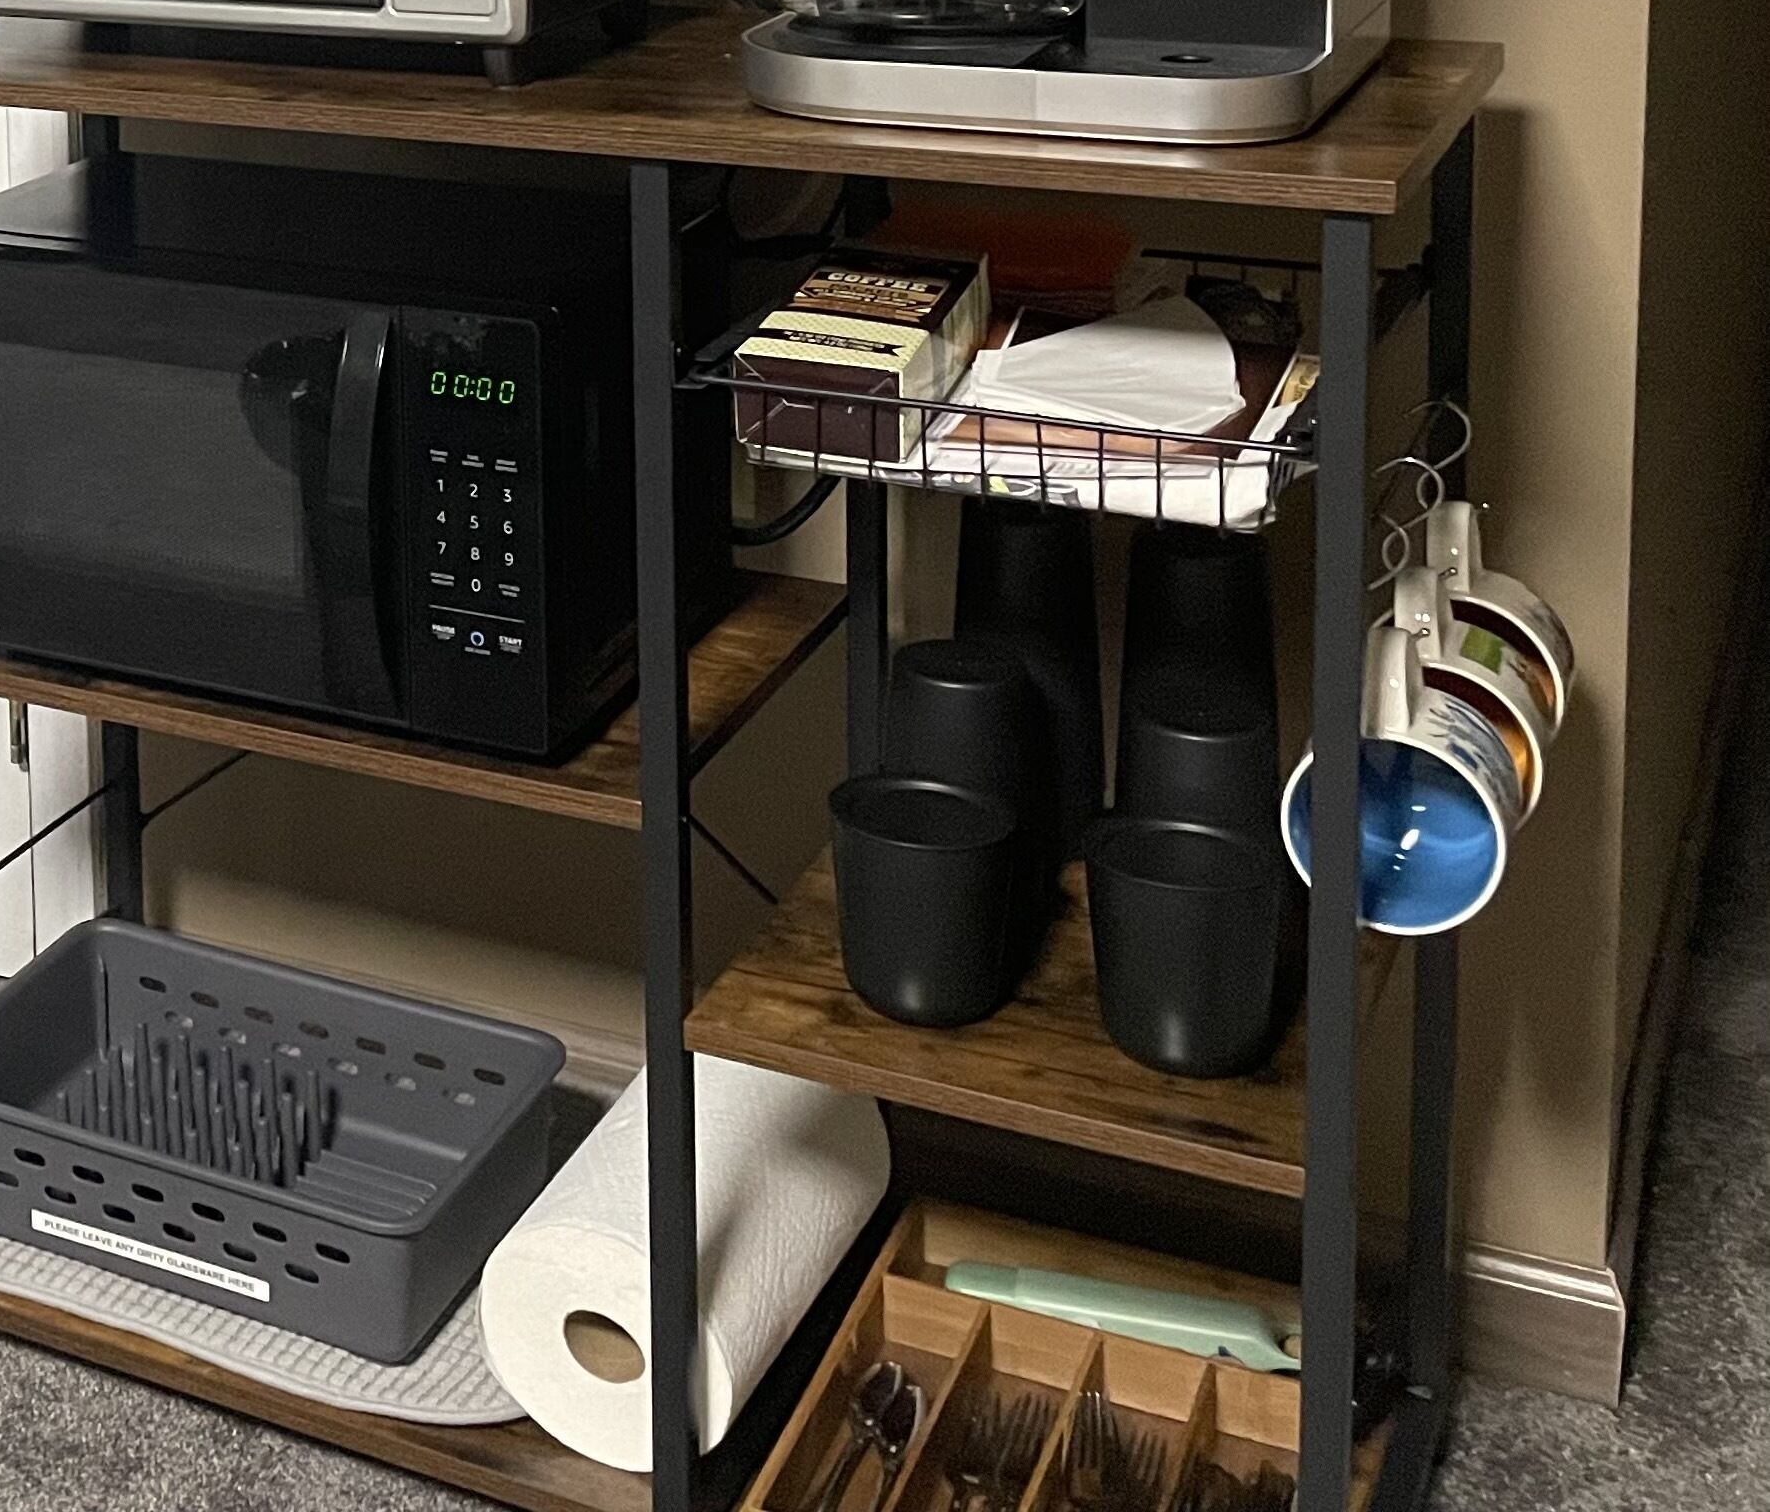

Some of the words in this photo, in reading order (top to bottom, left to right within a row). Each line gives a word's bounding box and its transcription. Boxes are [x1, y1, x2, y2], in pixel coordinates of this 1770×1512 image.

[827, 272, 929, 293] COFFEE
[430, 371, 516, 404] 00:00
[436, 478, 445, 493] 1
[468, 483, 479, 498] 2
[503, 488, 513, 503] 3
[436, 510, 447, 524] 4
[469, 515, 480, 530] 5
[503, 520, 514, 535] 6
[437, 541, 448, 555] 7
[470, 546, 481, 561] 8
[504, 552, 515, 567] 9
[470, 578, 482, 592] 0
[43, 1218, 81, 1237] PLEASE
[82, 1230, 113, 1248] LEAVE
[115, 1240, 135, 1254] ANY
[137, 1246, 166, 1264] DIRTY
[166, 1256, 226, 1283] GLASSWARE
[227, 1275, 256, 1293] HERE
